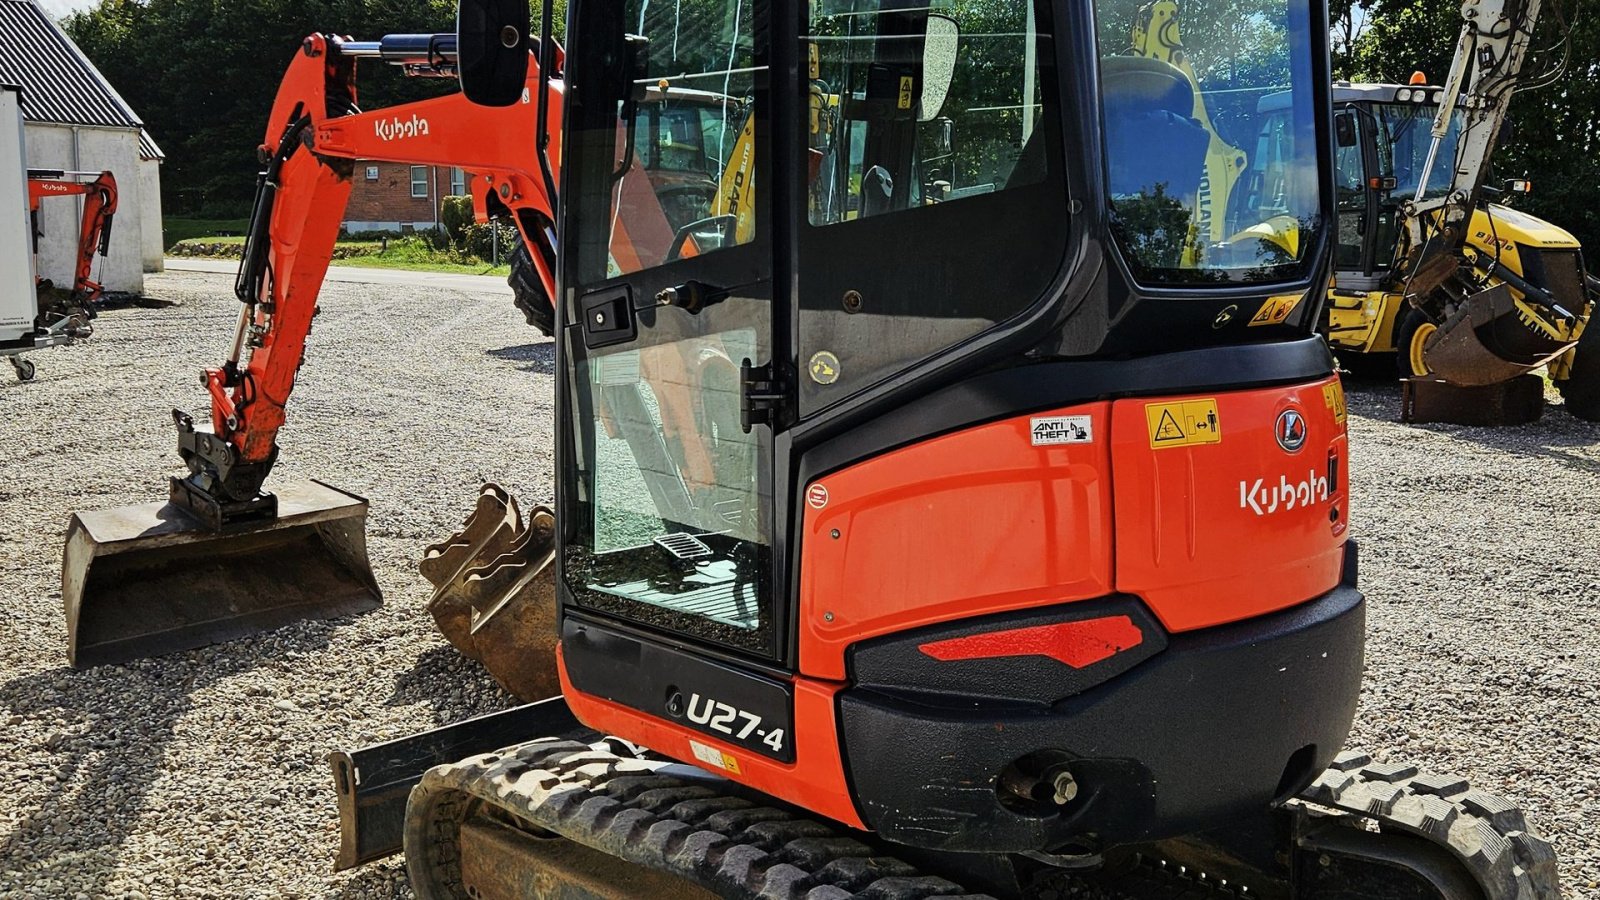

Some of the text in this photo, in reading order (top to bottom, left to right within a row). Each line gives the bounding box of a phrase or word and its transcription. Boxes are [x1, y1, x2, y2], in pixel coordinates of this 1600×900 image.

[375, 114, 429, 141] Kubota
[41, 183, 68, 192] Kubota
[1033, 422, 1064, 431] ANTI
[1033, 430, 1070, 439] THEFT
[1240, 468, 1328, 516] Kubota
[687, 693, 784, 752] U27-4
